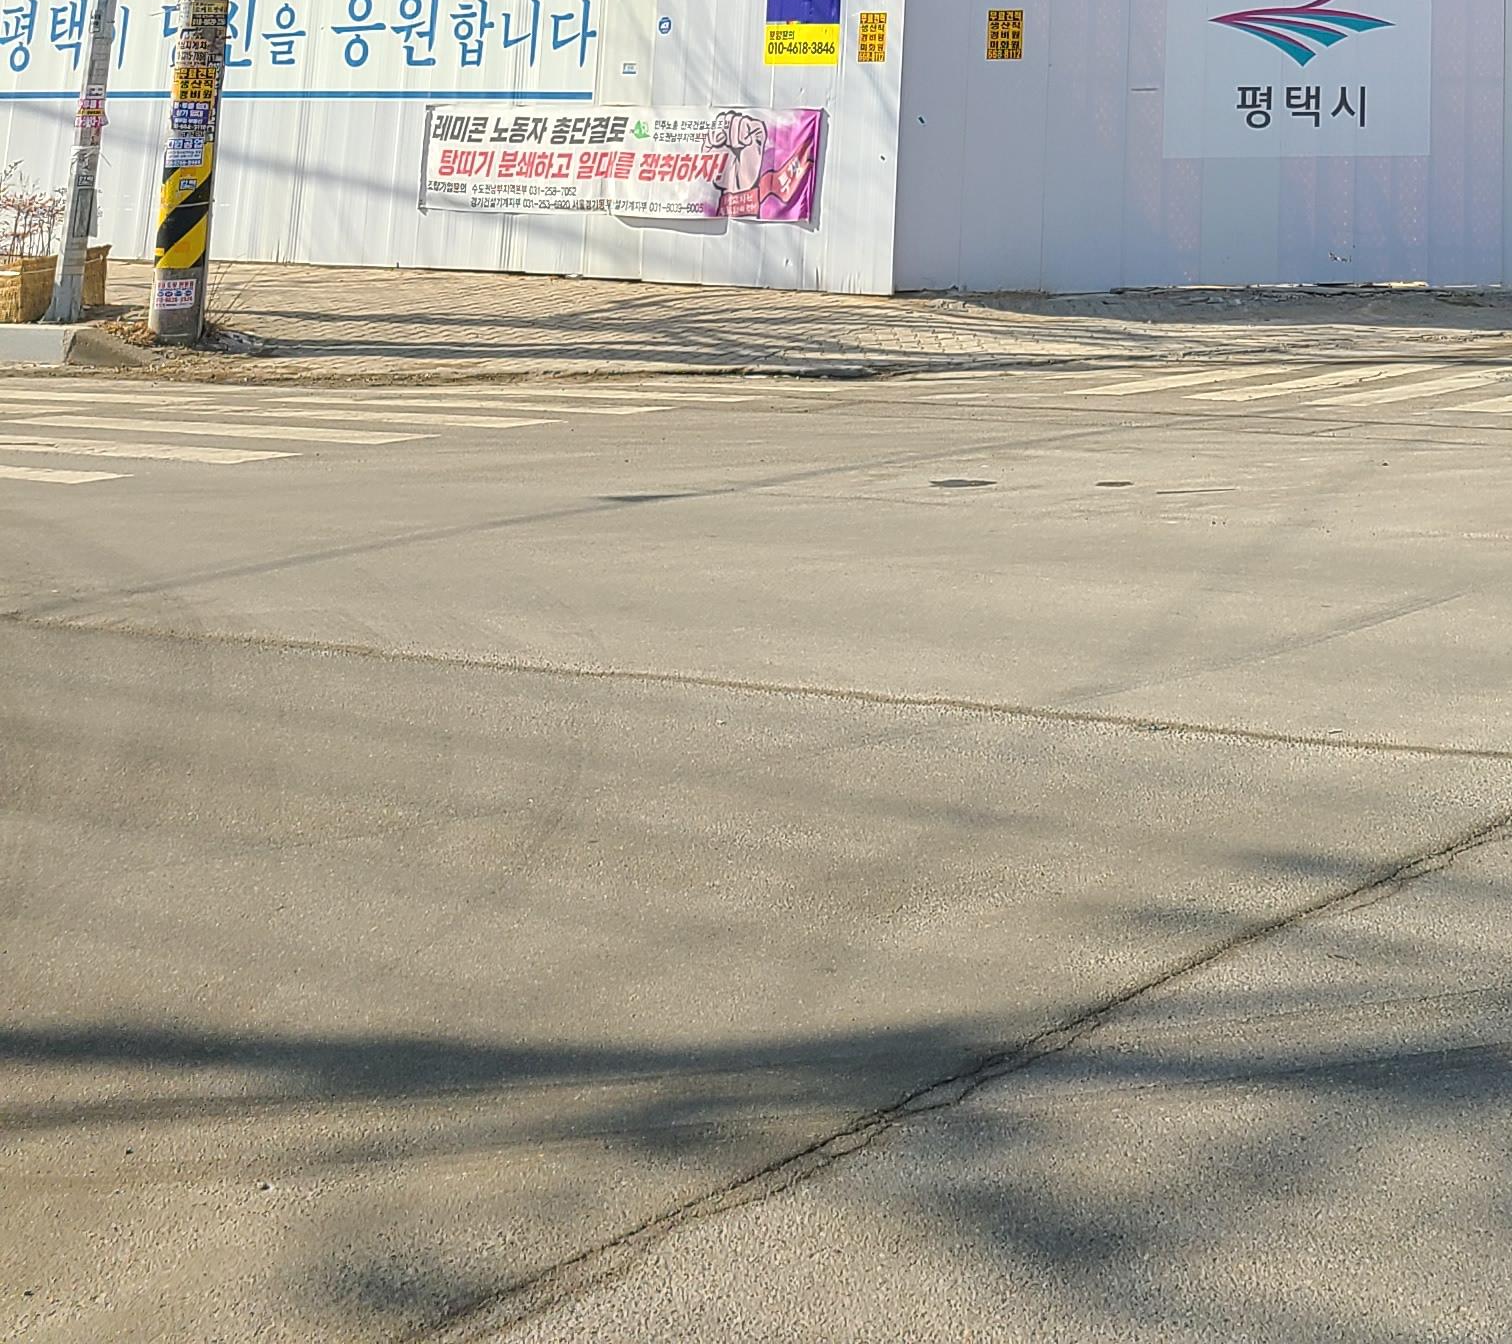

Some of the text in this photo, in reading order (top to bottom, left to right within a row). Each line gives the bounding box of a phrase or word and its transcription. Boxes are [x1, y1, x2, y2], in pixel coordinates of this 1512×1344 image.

[768, 41, 835, 54] 010-4618-3846
[180, 79, 213, 89] 생산직
[1236, 86, 1366, 129] 평택시
[432, 114, 629, 145] 레미콘 노동자 총단결로
[438, 149, 730, 182] 탕띠기 분쇄하고 일대를 쟁취하자!
[427, 180, 467, 193] 조합가입문의
